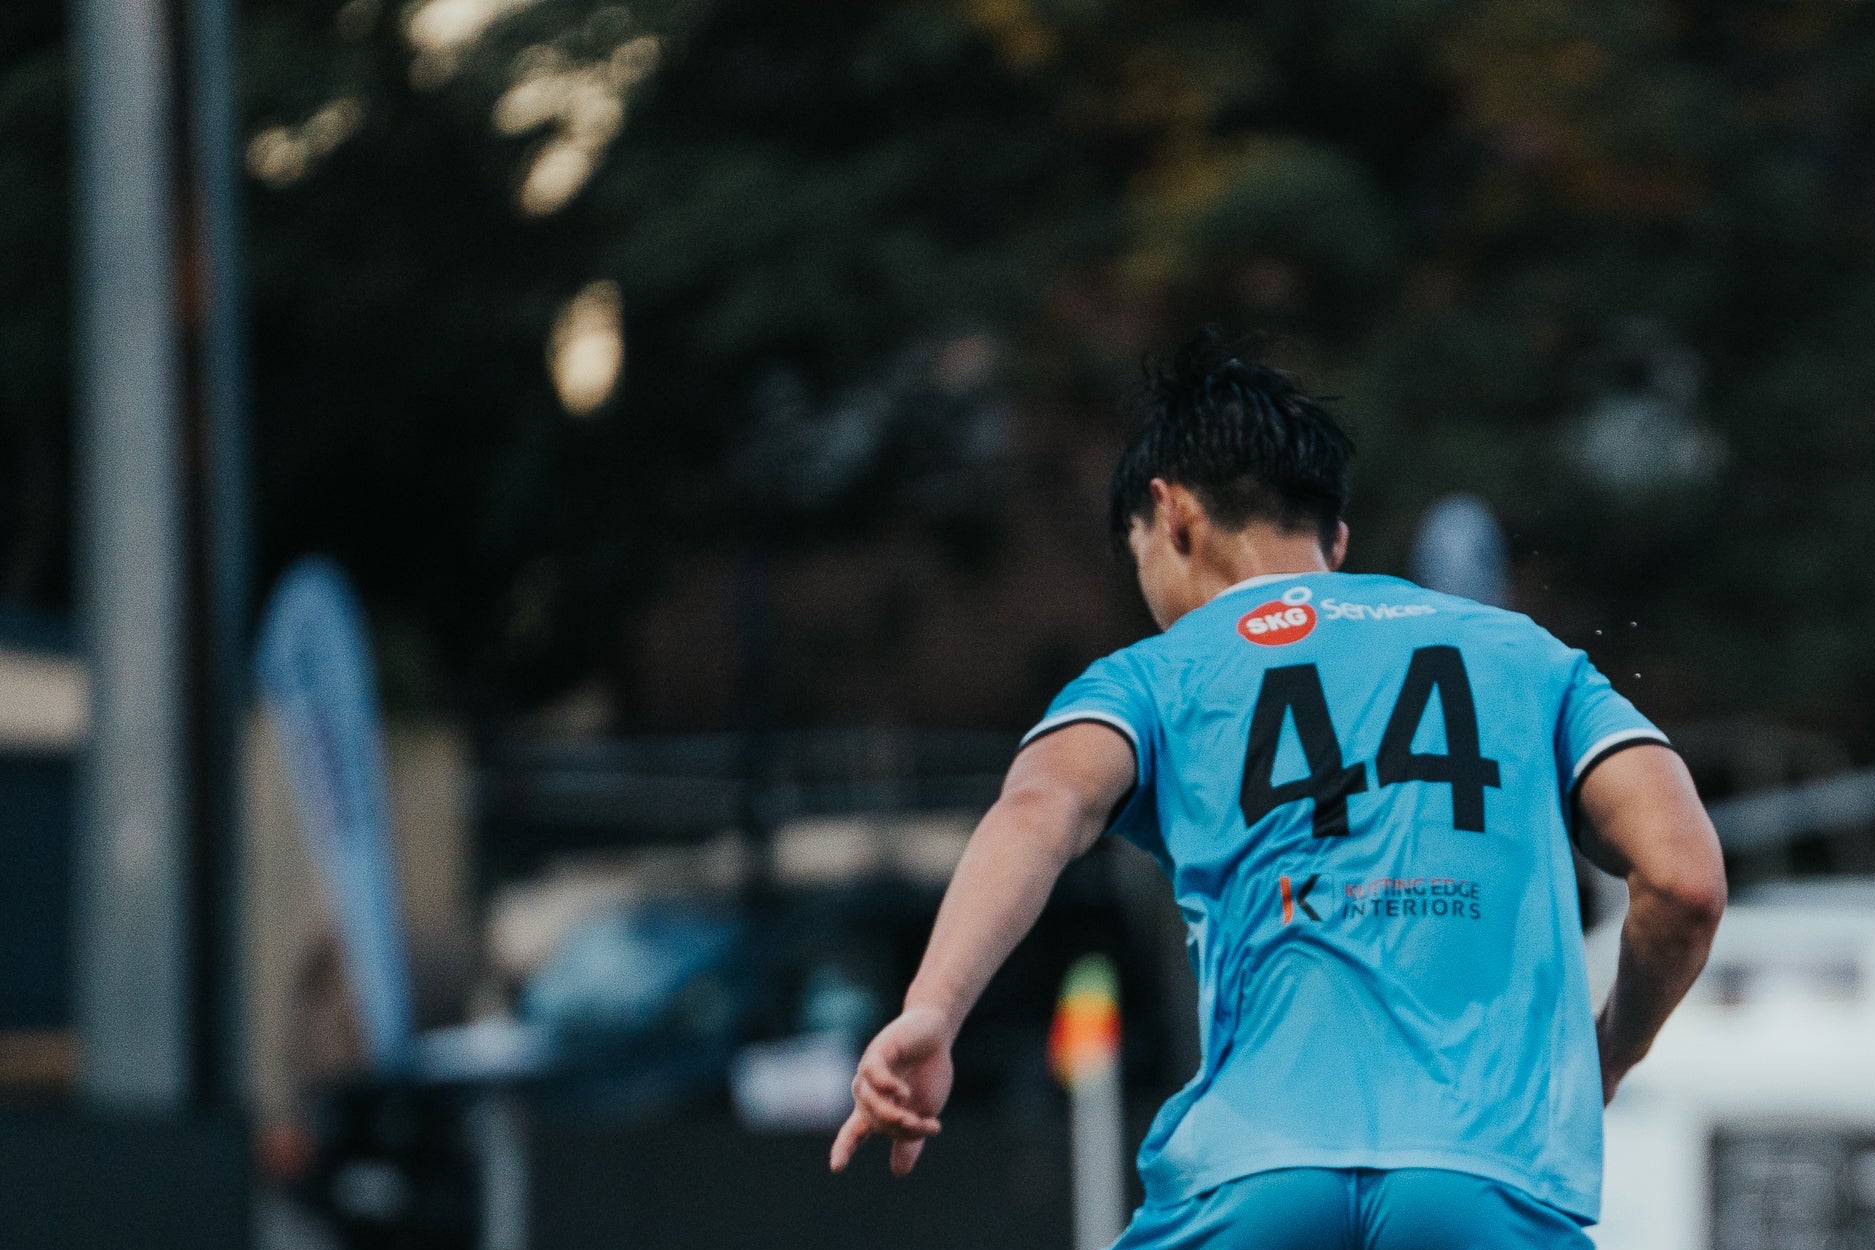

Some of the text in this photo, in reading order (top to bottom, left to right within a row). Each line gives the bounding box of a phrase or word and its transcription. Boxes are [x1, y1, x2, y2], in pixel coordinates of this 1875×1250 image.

[1246, 598, 1436, 635] SKG Services
[1239, 644, 1501, 839] 44
[1431, 877, 1481, 900] EDGE
[1343, 899, 1481, 920] INTERIORS
